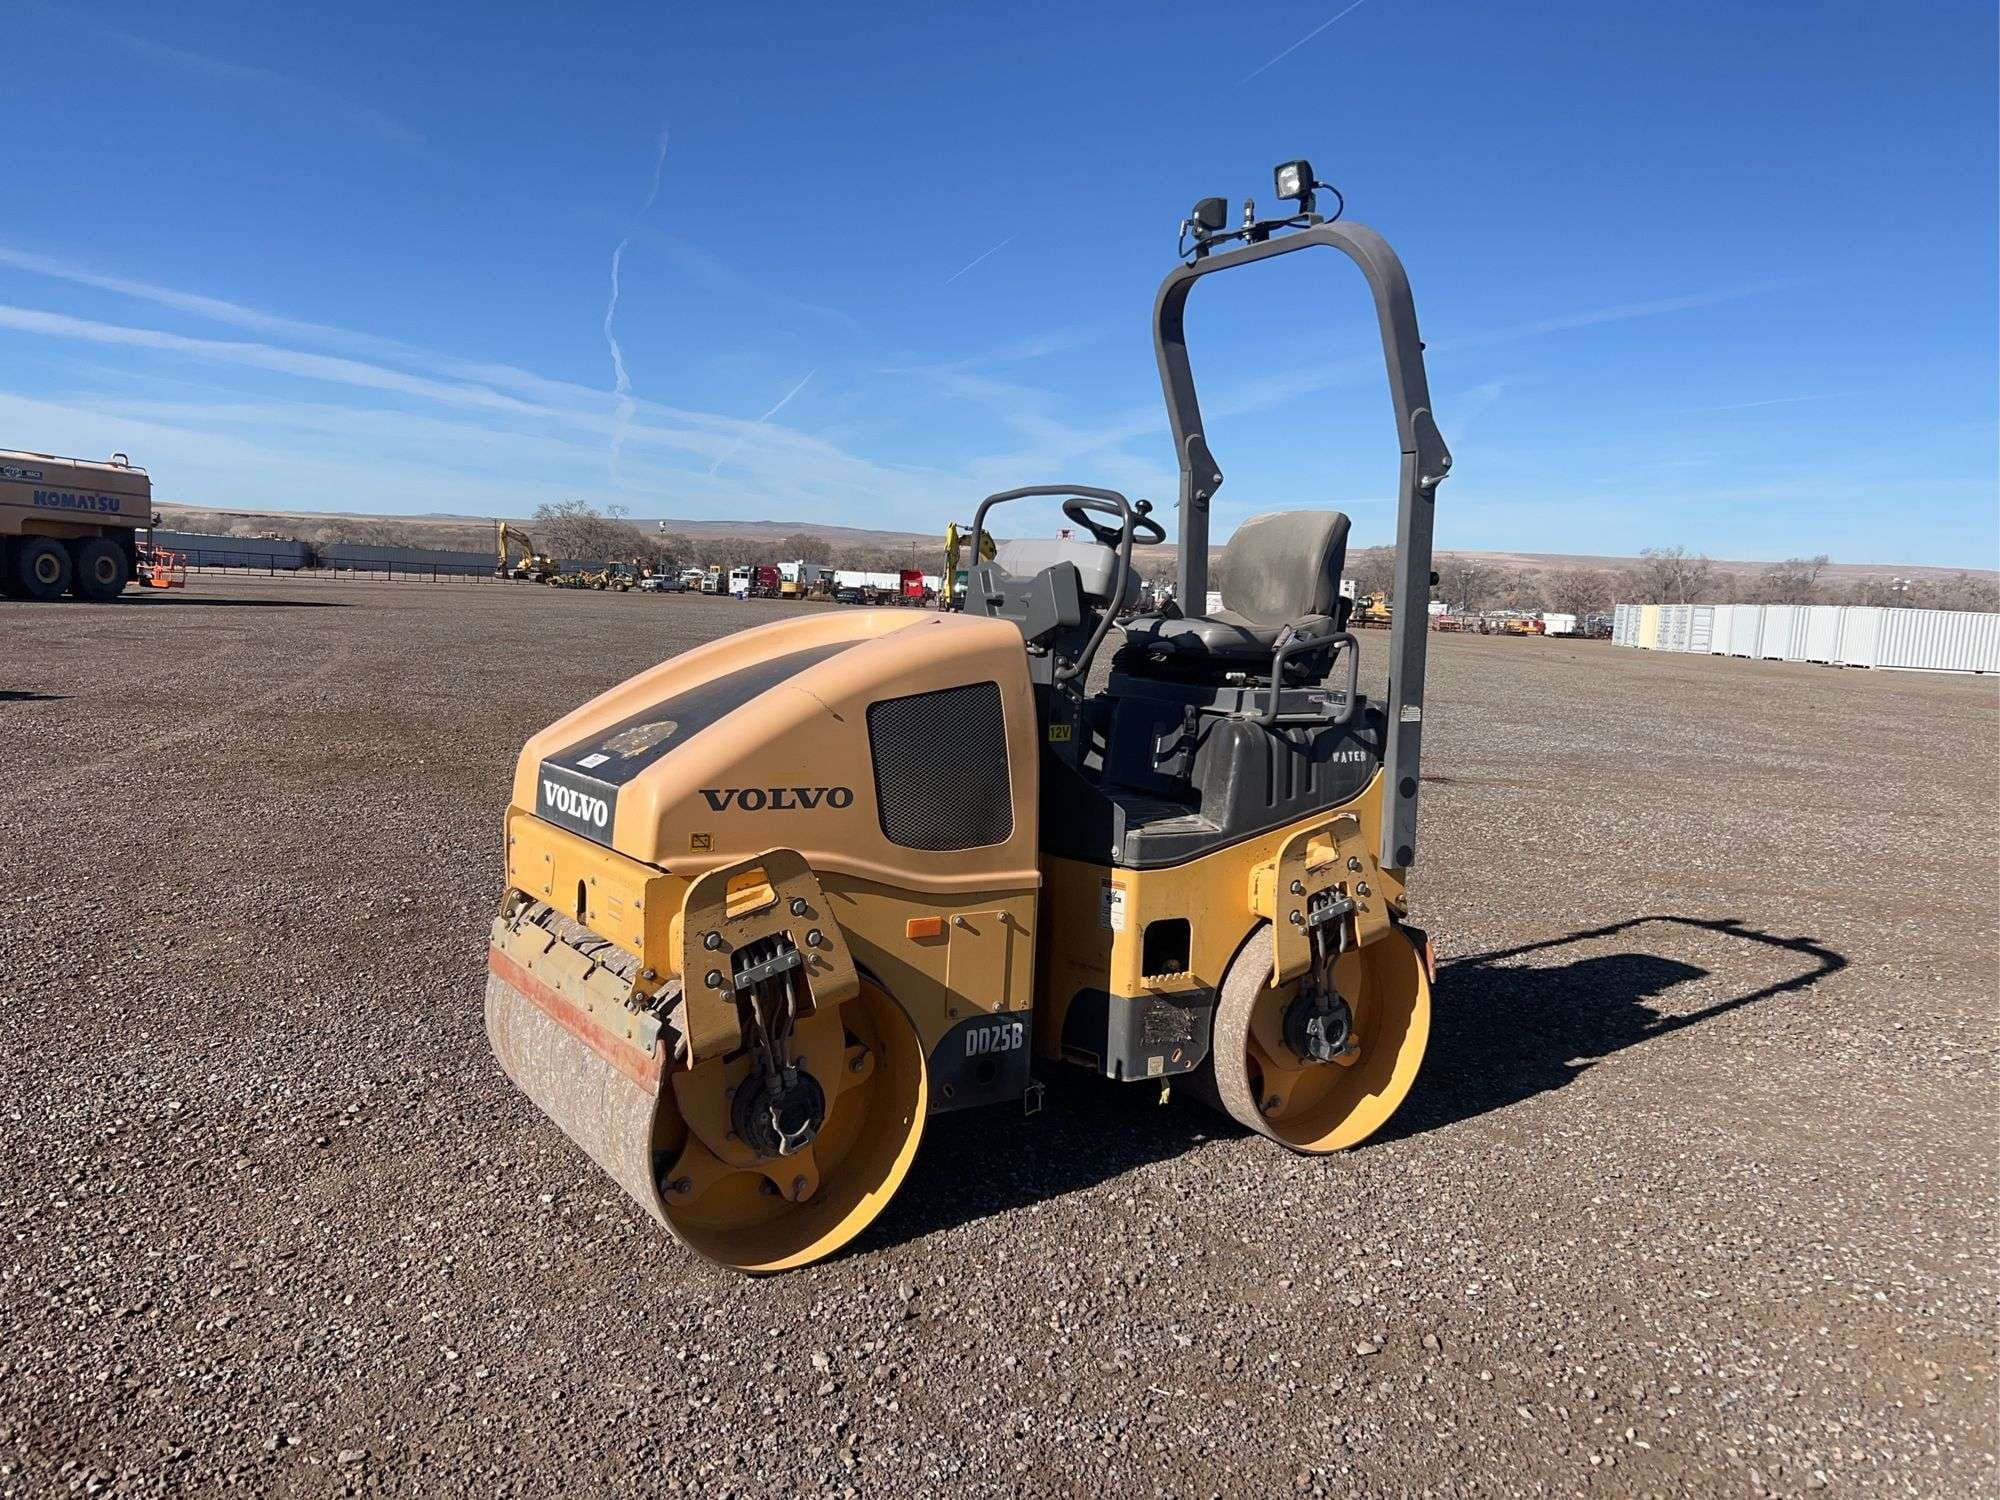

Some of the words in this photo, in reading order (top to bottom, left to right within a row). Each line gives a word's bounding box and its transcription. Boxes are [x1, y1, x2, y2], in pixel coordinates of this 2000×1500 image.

[33, 489, 121, 513] KOMATSU
[1051, 726, 1070, 738] 12V
[1332, 751, 1367, 763] WATER
[543, 779, 609, 828] VOLVO
[698, 787, 855, 812] VOLVO
[965, 1022, 1024, 1057] DD25B
